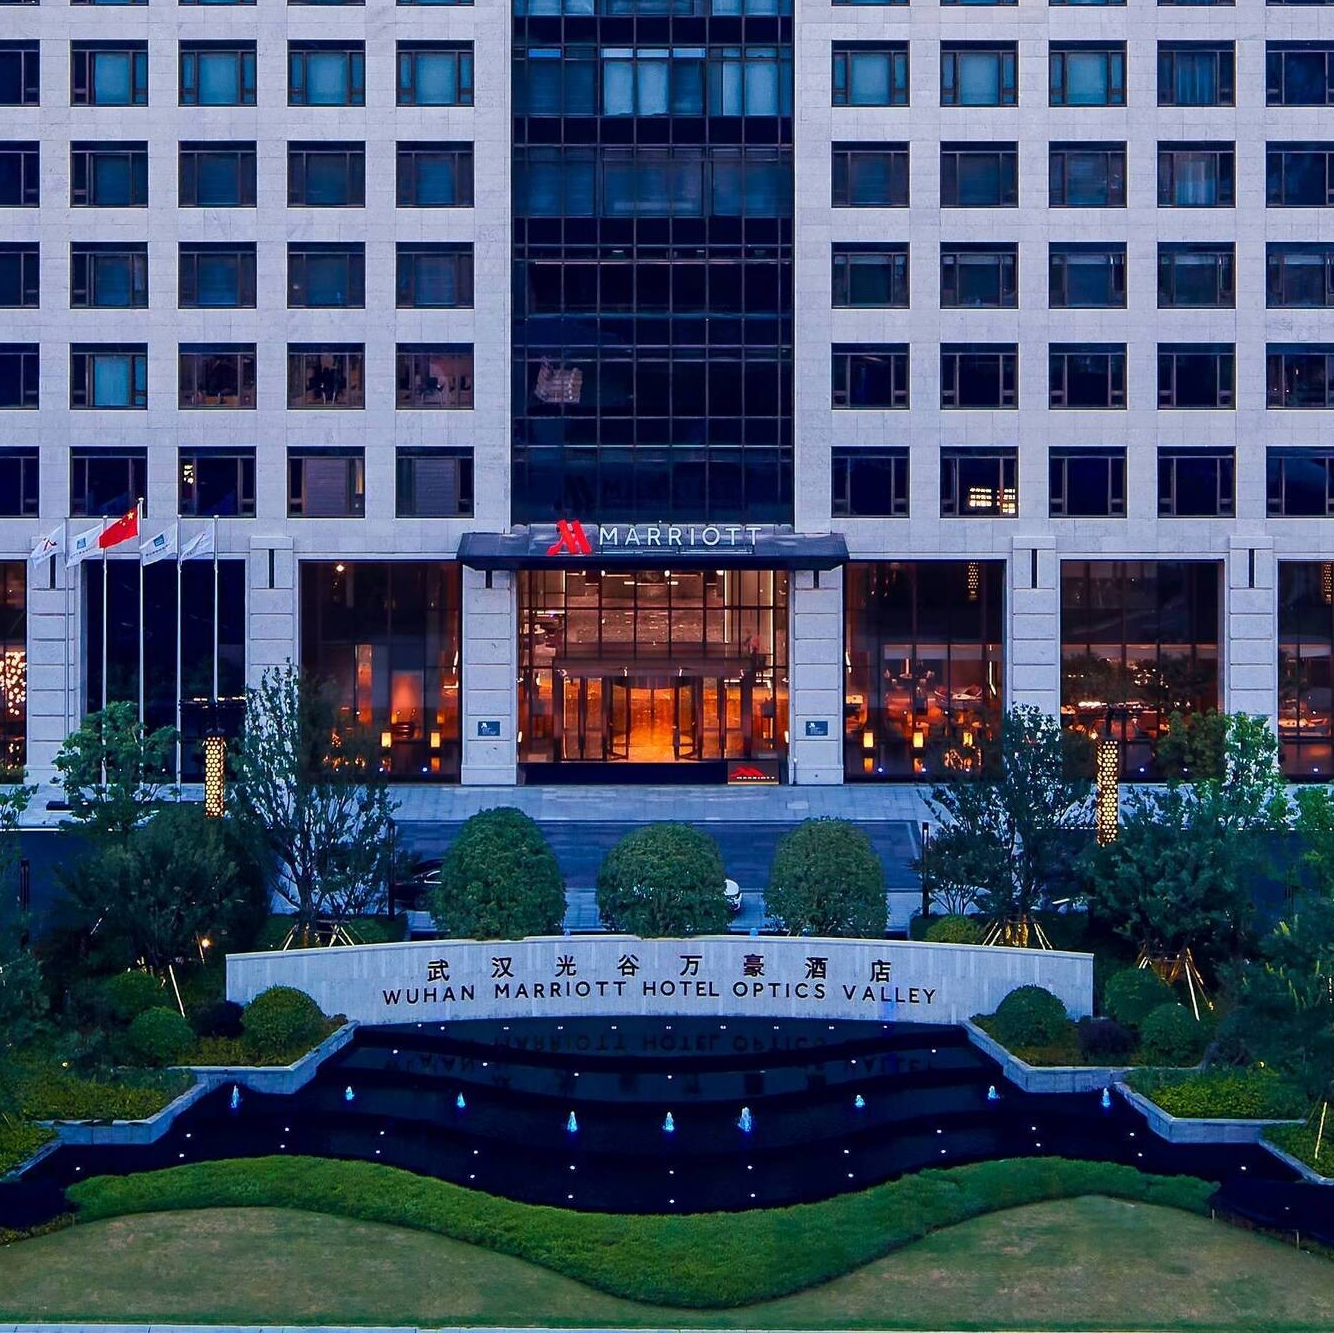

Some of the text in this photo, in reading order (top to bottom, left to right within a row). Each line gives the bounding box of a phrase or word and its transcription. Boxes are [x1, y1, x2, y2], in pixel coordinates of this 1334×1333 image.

[599, 526, 761, 546] MARRIOTT
[427, 954, 891, 982] 武汉光谷万豪酒店
[383, 981, 936, 1006] WUHAN MARRIOTT HOTEL OPTICS VALLEY
